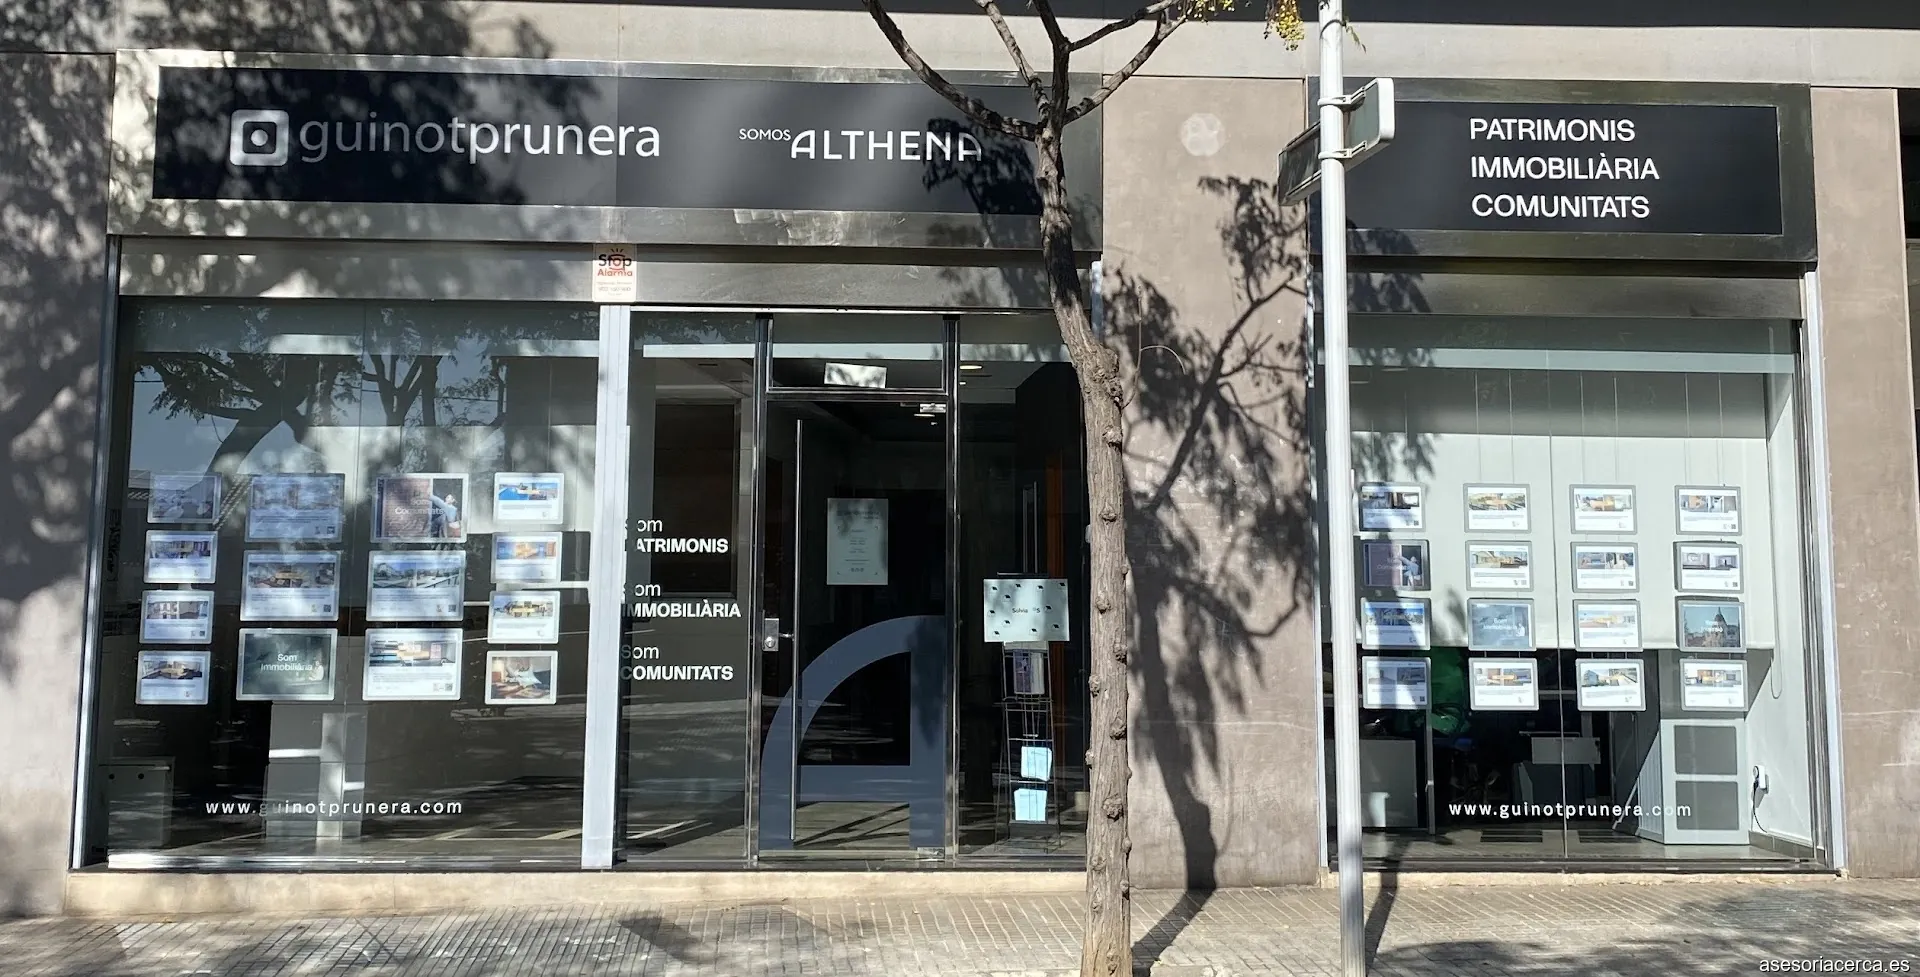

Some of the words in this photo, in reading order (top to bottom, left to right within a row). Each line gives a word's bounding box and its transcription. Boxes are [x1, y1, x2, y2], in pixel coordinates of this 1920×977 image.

[299, 112, 661, 165] guinotprunera
[1469, 118, 1636, 142] PATRIMONIS
[738, 128, 791, 142] SOMOS
[790, 129, 982, 162] ALTHENA
[1470, 153, 1660, 180] IMMOBILIÀRIA
[1471, 193, 1650, 219] COMUNITATS
[598, 254, 632, 271] Stop
[597, 268, 633, 277] Alarma
[626, 519, 663, 532] om
[626, 538, 729, 553] ATRIMONIS
[621, 599, 741, 618] IMMOBILIÀRIA
[277, 653, 297, 662] Som
[621, 644, 660, 659] Som
[620, 665, 734, 681] COMUNITATS
[205, 800, 463, 817] www.guinotprunera.com
[1448, 801, 1692, 819] www.guinotprunera.com
